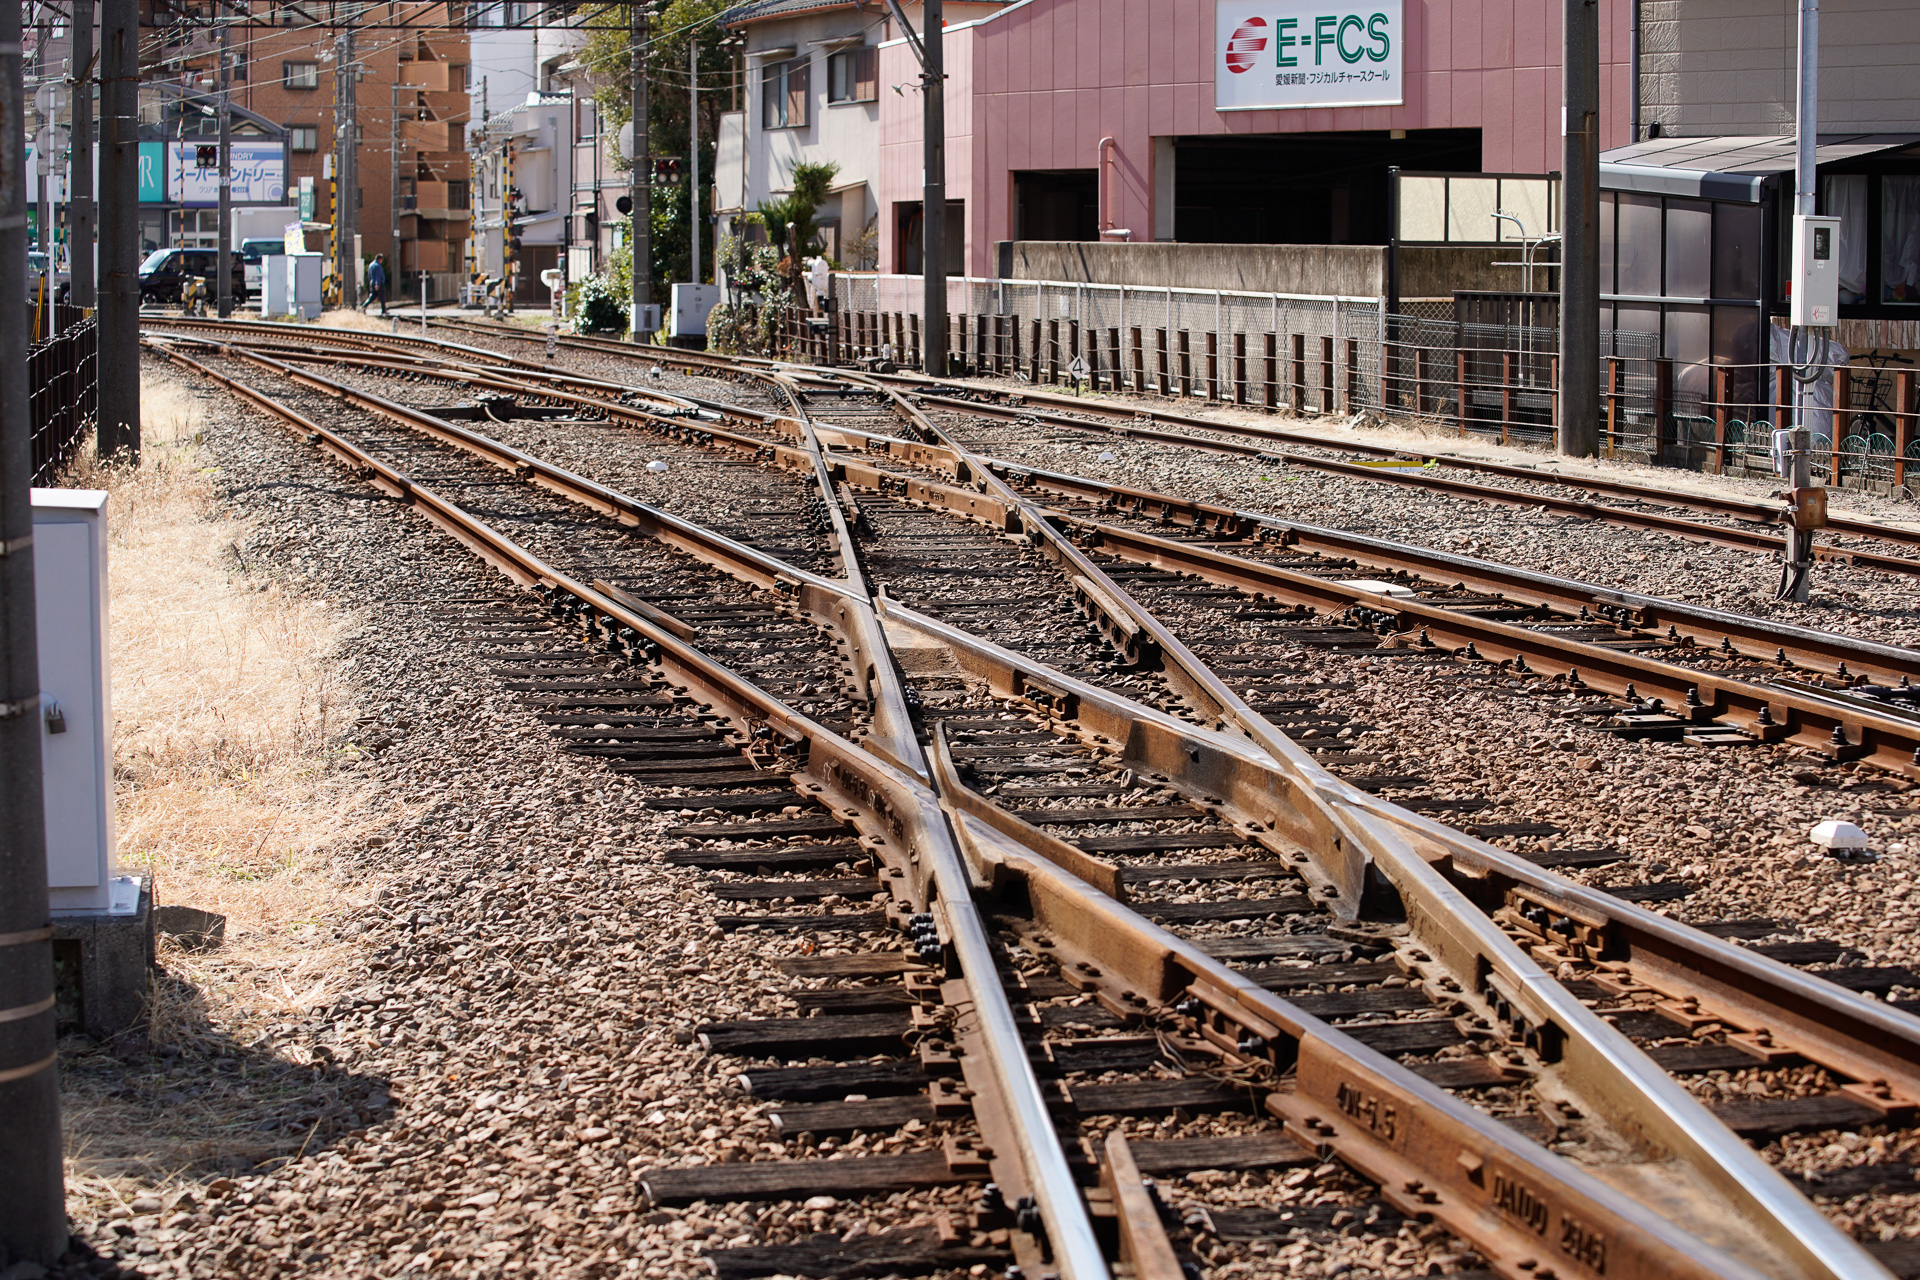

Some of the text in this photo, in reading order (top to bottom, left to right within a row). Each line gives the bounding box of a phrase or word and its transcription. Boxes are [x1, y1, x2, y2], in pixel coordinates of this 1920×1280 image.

[1276, 12, 1391, 67] E-FCS
[174, 167, 275, 182] スーパーンドリー
[1072, 358, 1084, 374] 4
